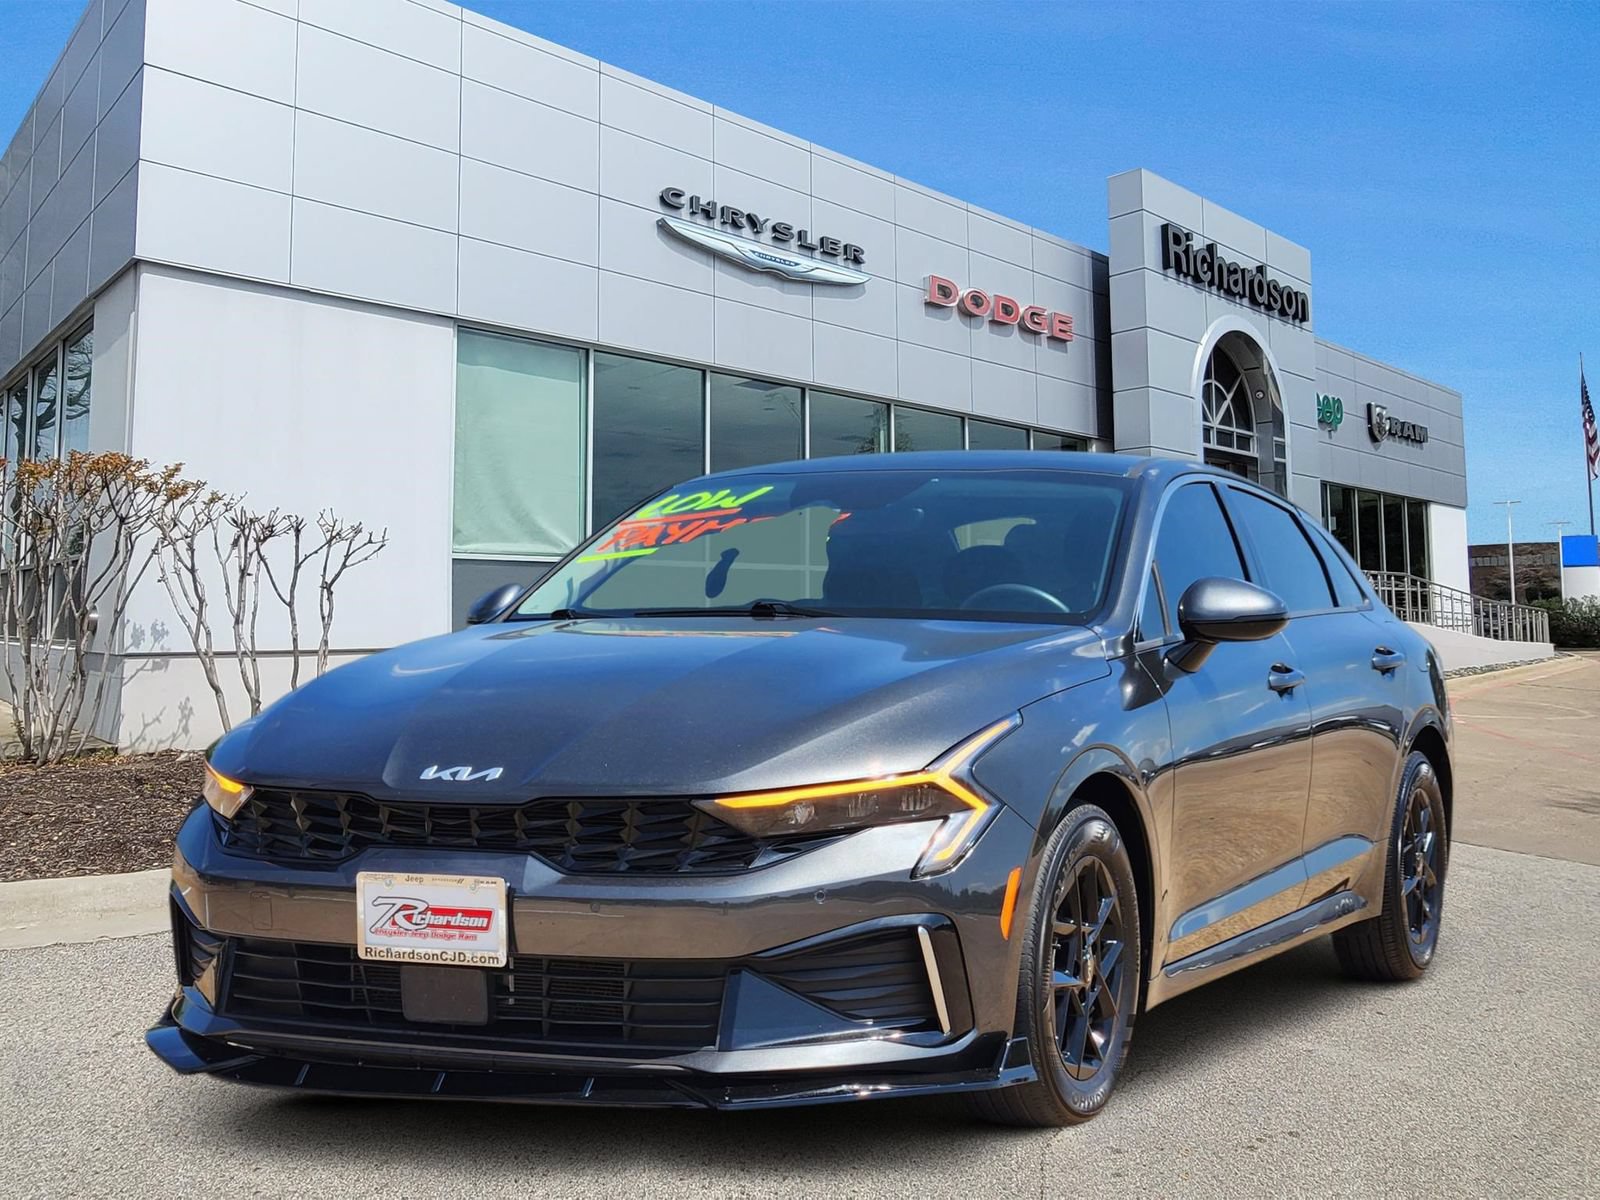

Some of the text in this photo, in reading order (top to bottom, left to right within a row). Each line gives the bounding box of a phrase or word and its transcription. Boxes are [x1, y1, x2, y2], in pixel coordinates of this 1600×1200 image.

[659, 187, 866, 264] CHRYSLER
[1161, 223, 1310, 323] Richardson
[924, 274, 1075, 342] DODGE
[1387, 416, 1428, 443] RAM
[636, 486, 774, 518] LOW
[405, 875, 424, 885] Jeep
[370, 896, 489, 934] Richardson
[431, 930, 457, 941] Dodge
[364, 947, 500, 965] RichardsonCJD.com
